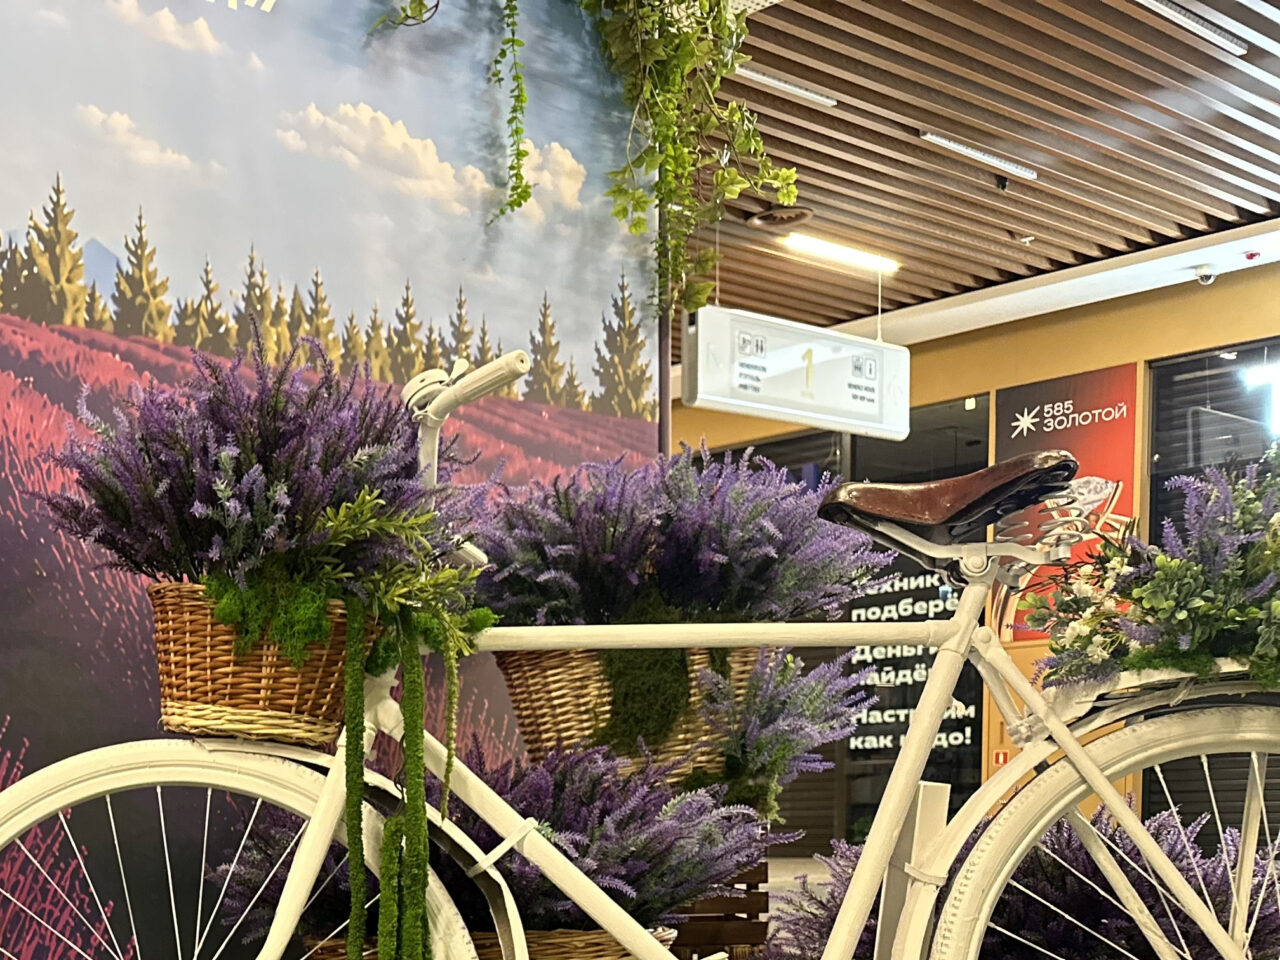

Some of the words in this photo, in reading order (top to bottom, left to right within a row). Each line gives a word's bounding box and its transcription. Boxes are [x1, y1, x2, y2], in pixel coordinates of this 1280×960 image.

[801, 347, 815, 392] 1
[1043, 400, 1074, 418] 585
[1043, 401, 1128, 432] ЗОЛОТОЙ
[851, 592, 959, 622] подберё
[849, 734, 894, 750] как
